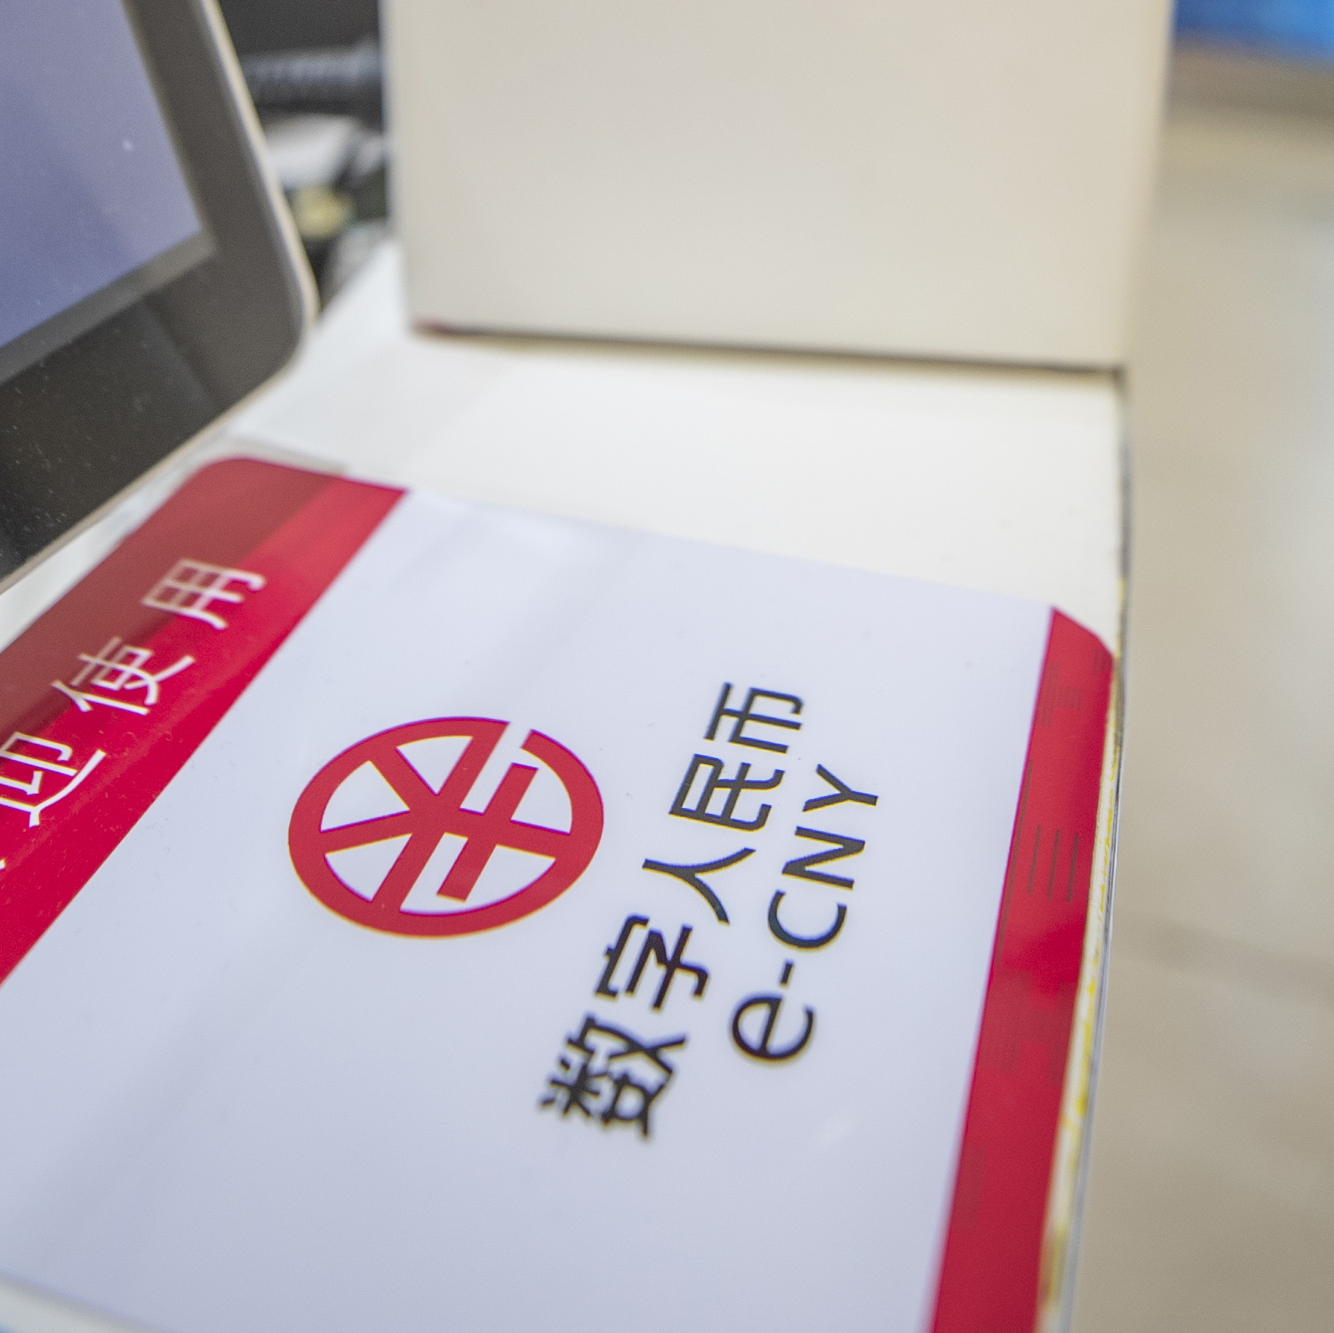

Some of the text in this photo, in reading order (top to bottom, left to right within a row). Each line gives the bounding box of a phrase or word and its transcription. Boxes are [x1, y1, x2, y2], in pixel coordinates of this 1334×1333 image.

[539, 680, 807, 1141] 数字人民币
[730, 764, 880, 1067] e-CNY
